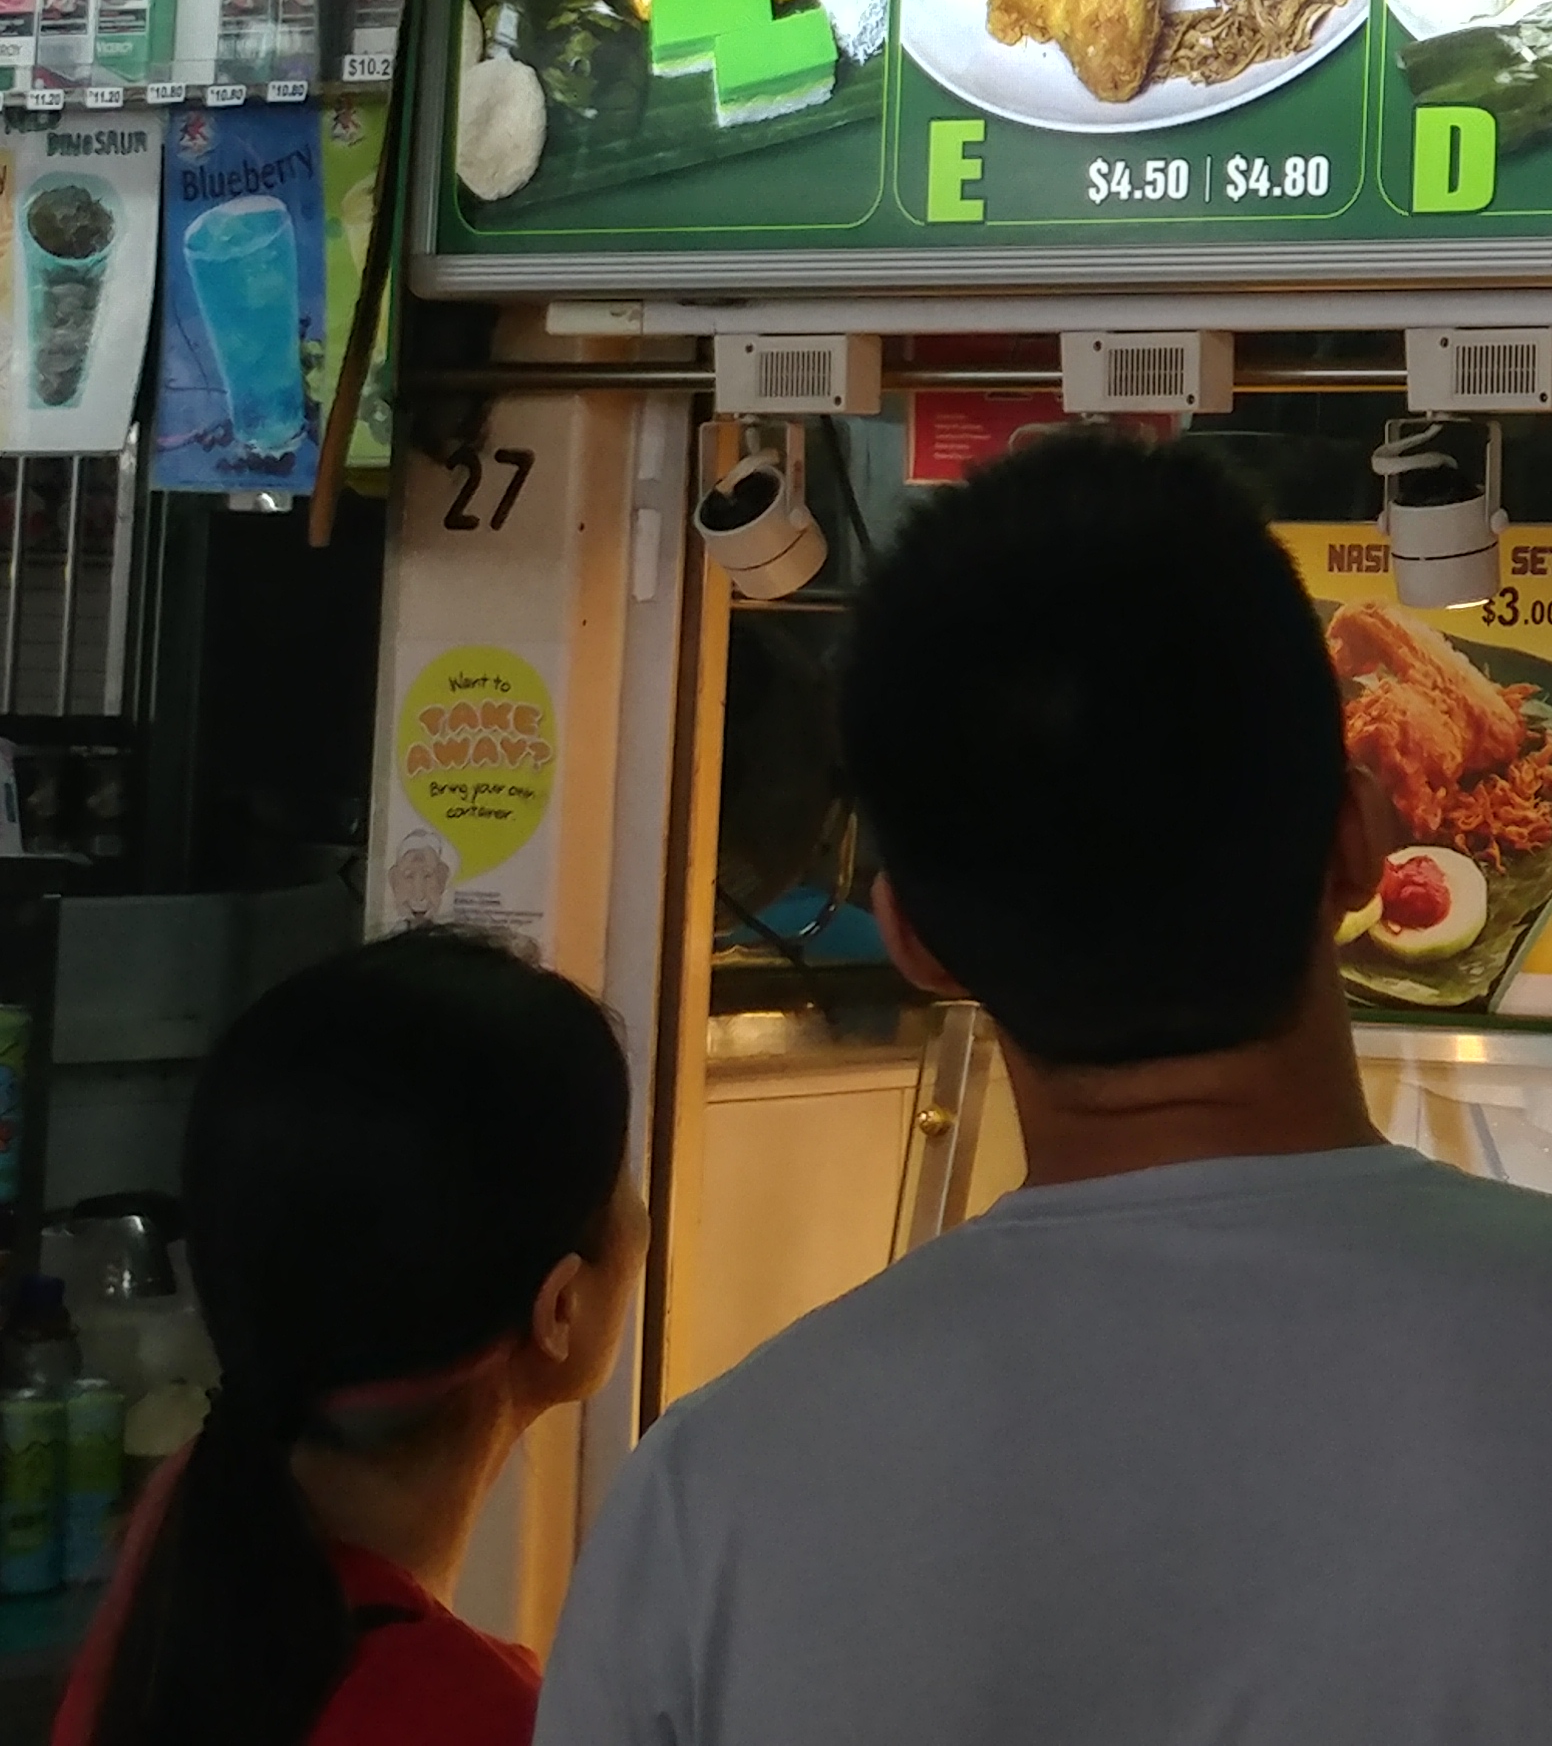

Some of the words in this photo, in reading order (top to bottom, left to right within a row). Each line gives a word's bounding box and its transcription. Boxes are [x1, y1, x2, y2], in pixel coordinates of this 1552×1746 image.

[180, 141, 316, 201] Blueberry
[926, 116, 988, 225] E
[1086, 154, 1191, 204] $4.50
[1225, 153, 1332, 202] $4.80
[1411, 104, 1498, 216] D
[443, 447, 536, 533] 27
[1327, 542, 1390, 575] NASI
